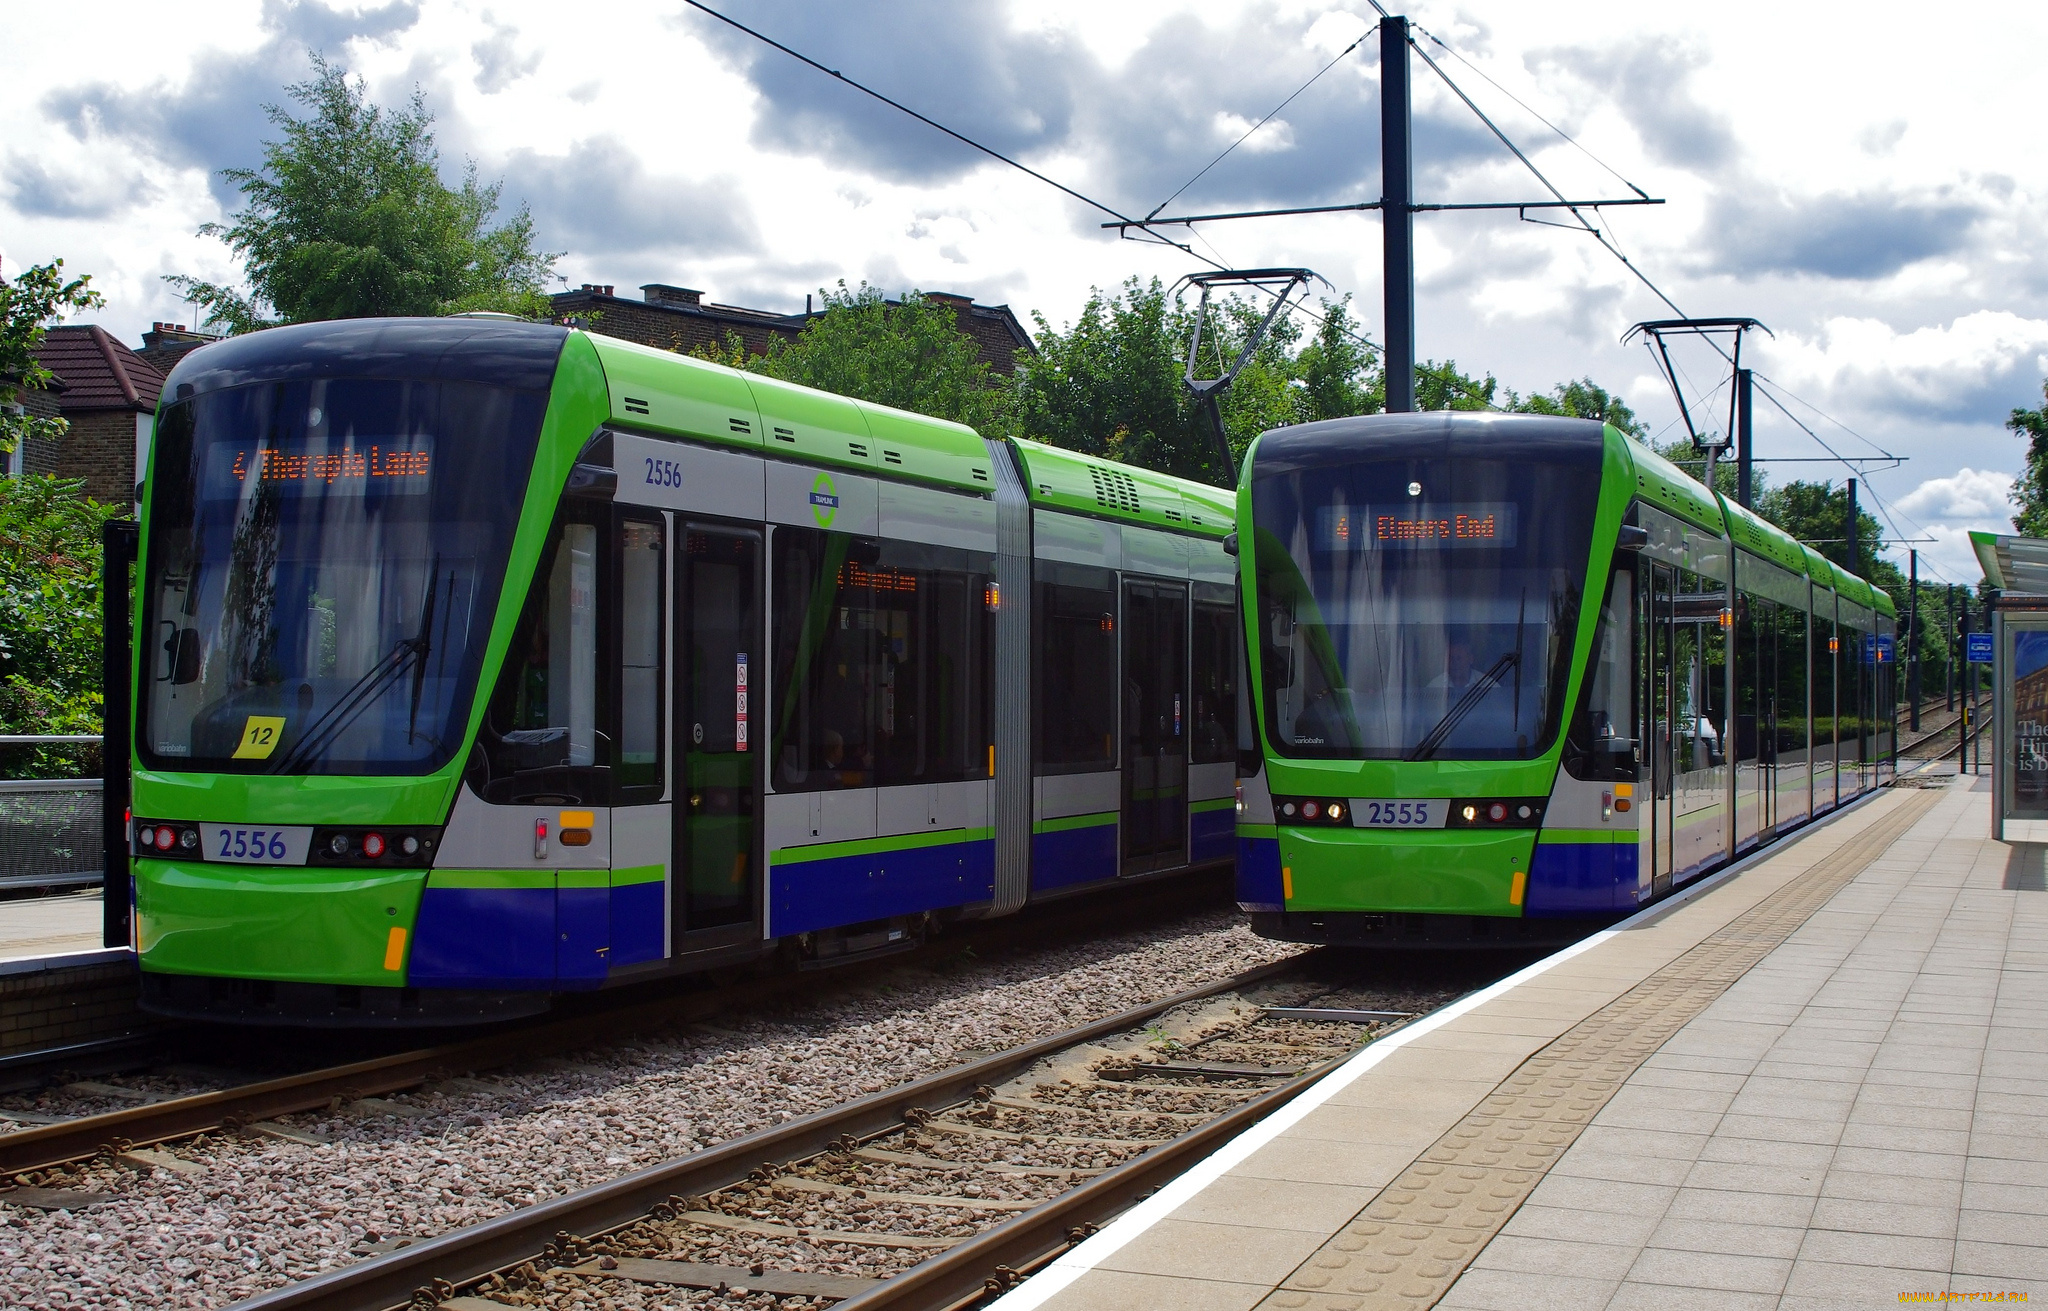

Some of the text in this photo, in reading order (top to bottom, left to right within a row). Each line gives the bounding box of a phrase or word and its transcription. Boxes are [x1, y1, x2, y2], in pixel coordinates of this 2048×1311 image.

[233, 445, 429, 484] 4 Therapia Lane
[645, 457, 682, 488] 2556
[1336, 514, 1494, 540] 4 Elmers End
[250, 727, 273, 745] 12
[2018, 719, 2048, 736] The
[2019, 755, 2033, 771] is
[1368, 803, 1428, 825] 2555
[219, 829, 287, 859] 2556
